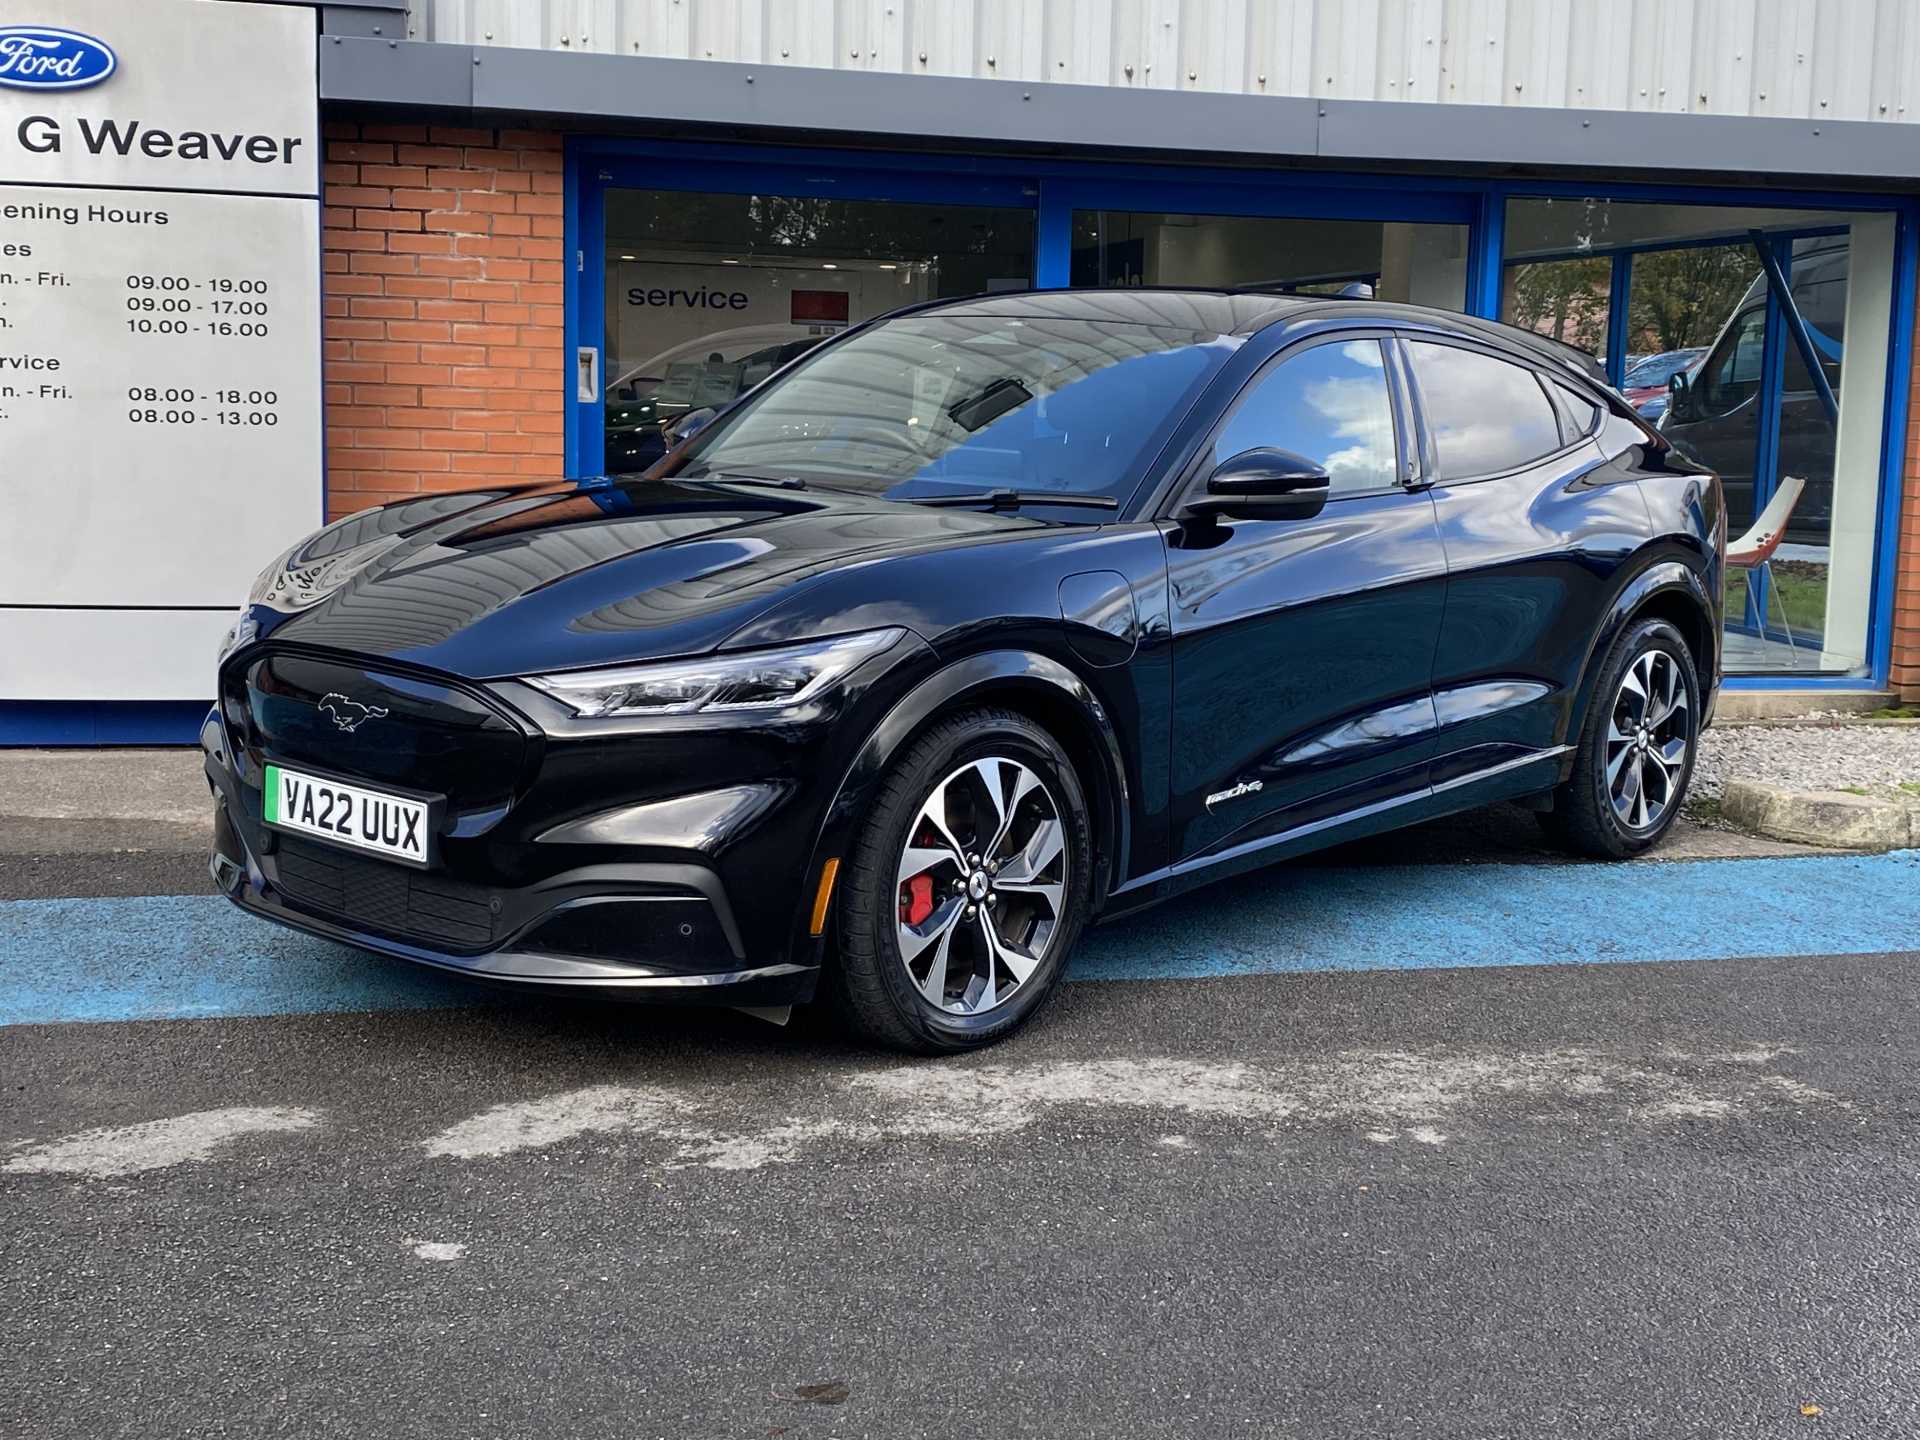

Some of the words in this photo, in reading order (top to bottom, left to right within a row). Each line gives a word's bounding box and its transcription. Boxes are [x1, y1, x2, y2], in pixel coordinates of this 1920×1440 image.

[0, 36, 84, 77] Ford
[17, 115, 61, 154] G
[77, 118, 303, 165] Weaver
[0, 202, 79, 225] ening
[88, 204, 169, 225] Hours
[3, 244, 32, 257] es
[38, 271, 71, 287] Fri.
[126, 275, 190, 291] 09.00
[208, 279, 268, 295] 19.00
[127, 297, 191, 313] 09.00
[211, 300, 268, 316] 17.00
[627, 285, 749, 310] service
[127, 319, 188, 334] 10.00
[207, 322, 268, 337] 16.00
[0, 354, 60, 371] rvice
[40, 384, 73, 399] Fri.
[128, 387, 195, 403] 08.00
[215, 390, 278, 405] 18.00
[128, 408, 195, 424] 08.00
[217, 411, 278, 426] 13.00
[285, 778, 353, 836] VA22
[362, 798, 421, 853] UUX
